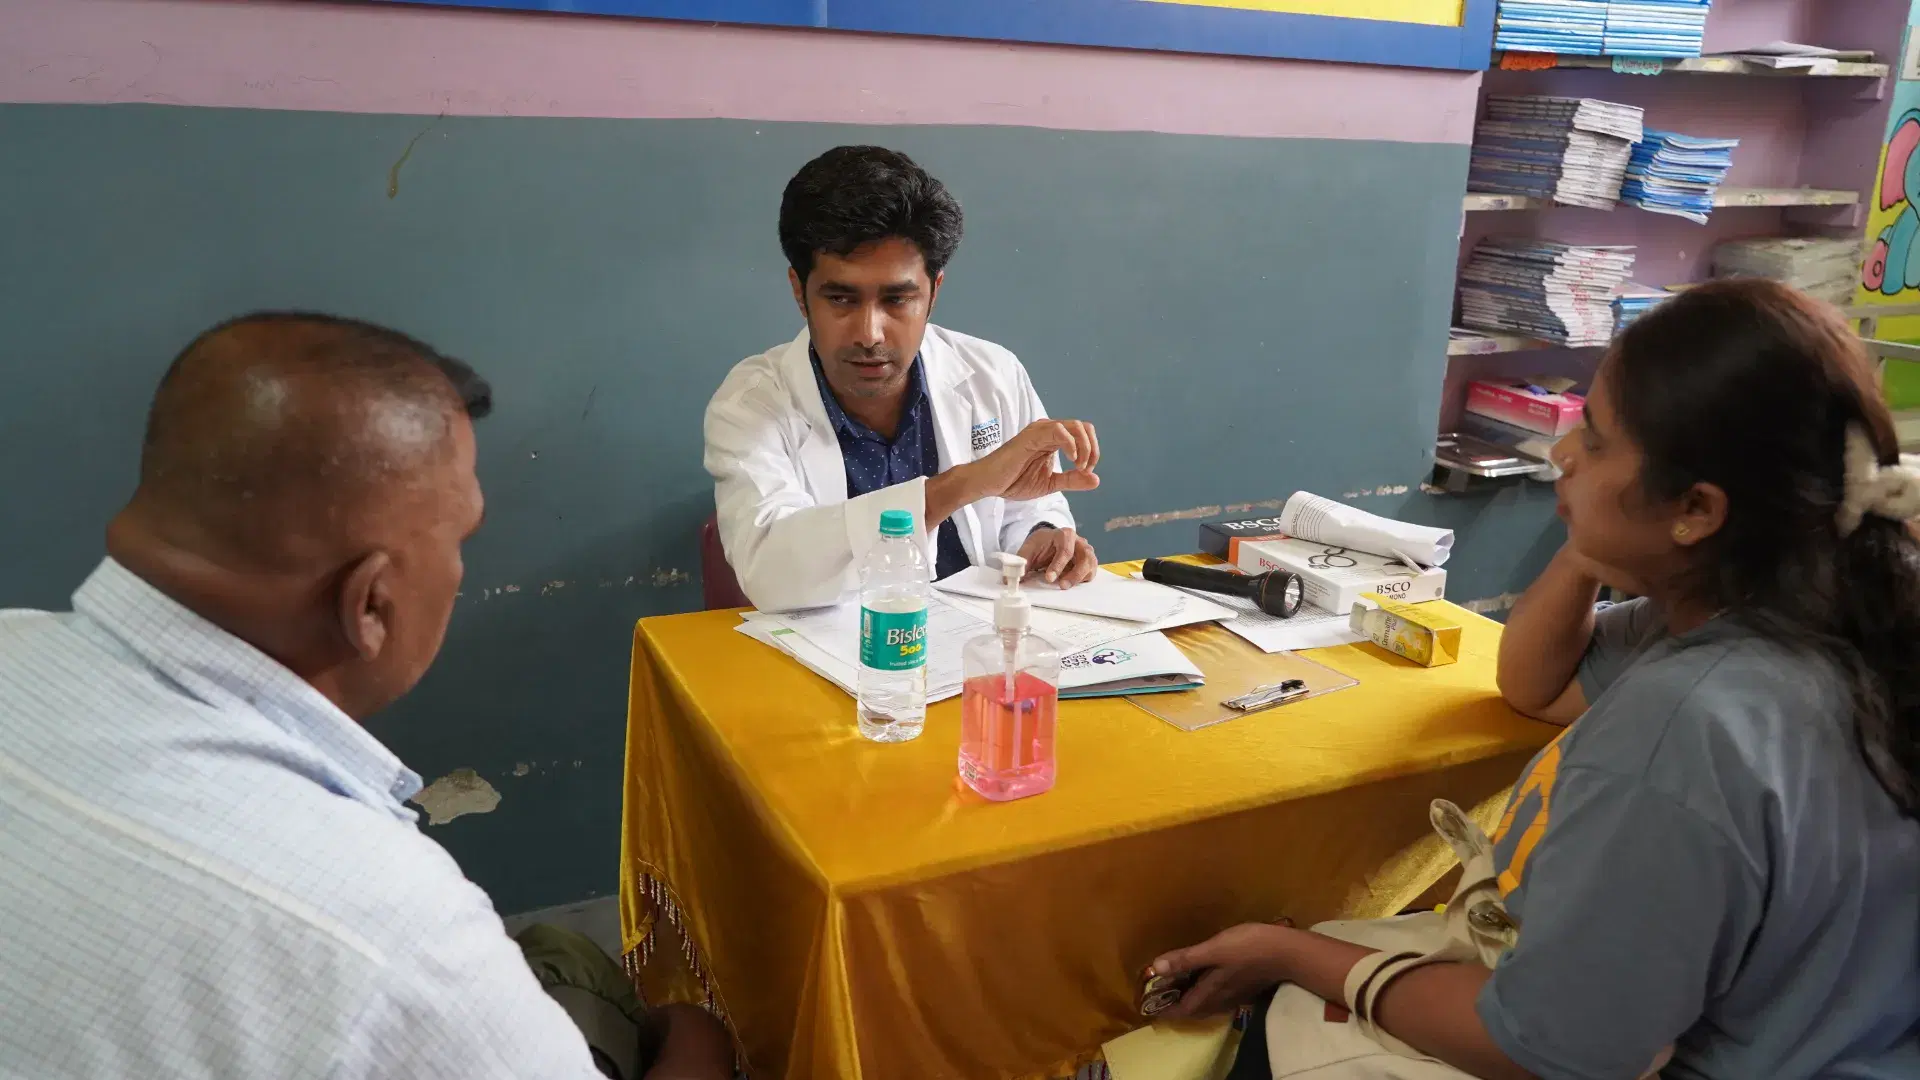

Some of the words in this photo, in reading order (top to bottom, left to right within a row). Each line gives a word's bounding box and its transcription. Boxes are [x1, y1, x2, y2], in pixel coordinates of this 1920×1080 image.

[971, 423, 1000, 439] GASTRO
[972, 431, 1001, 446] CENTRE
[1376, 581, 1411, 594] BSCO
[900, 644, 921, 657] 500
